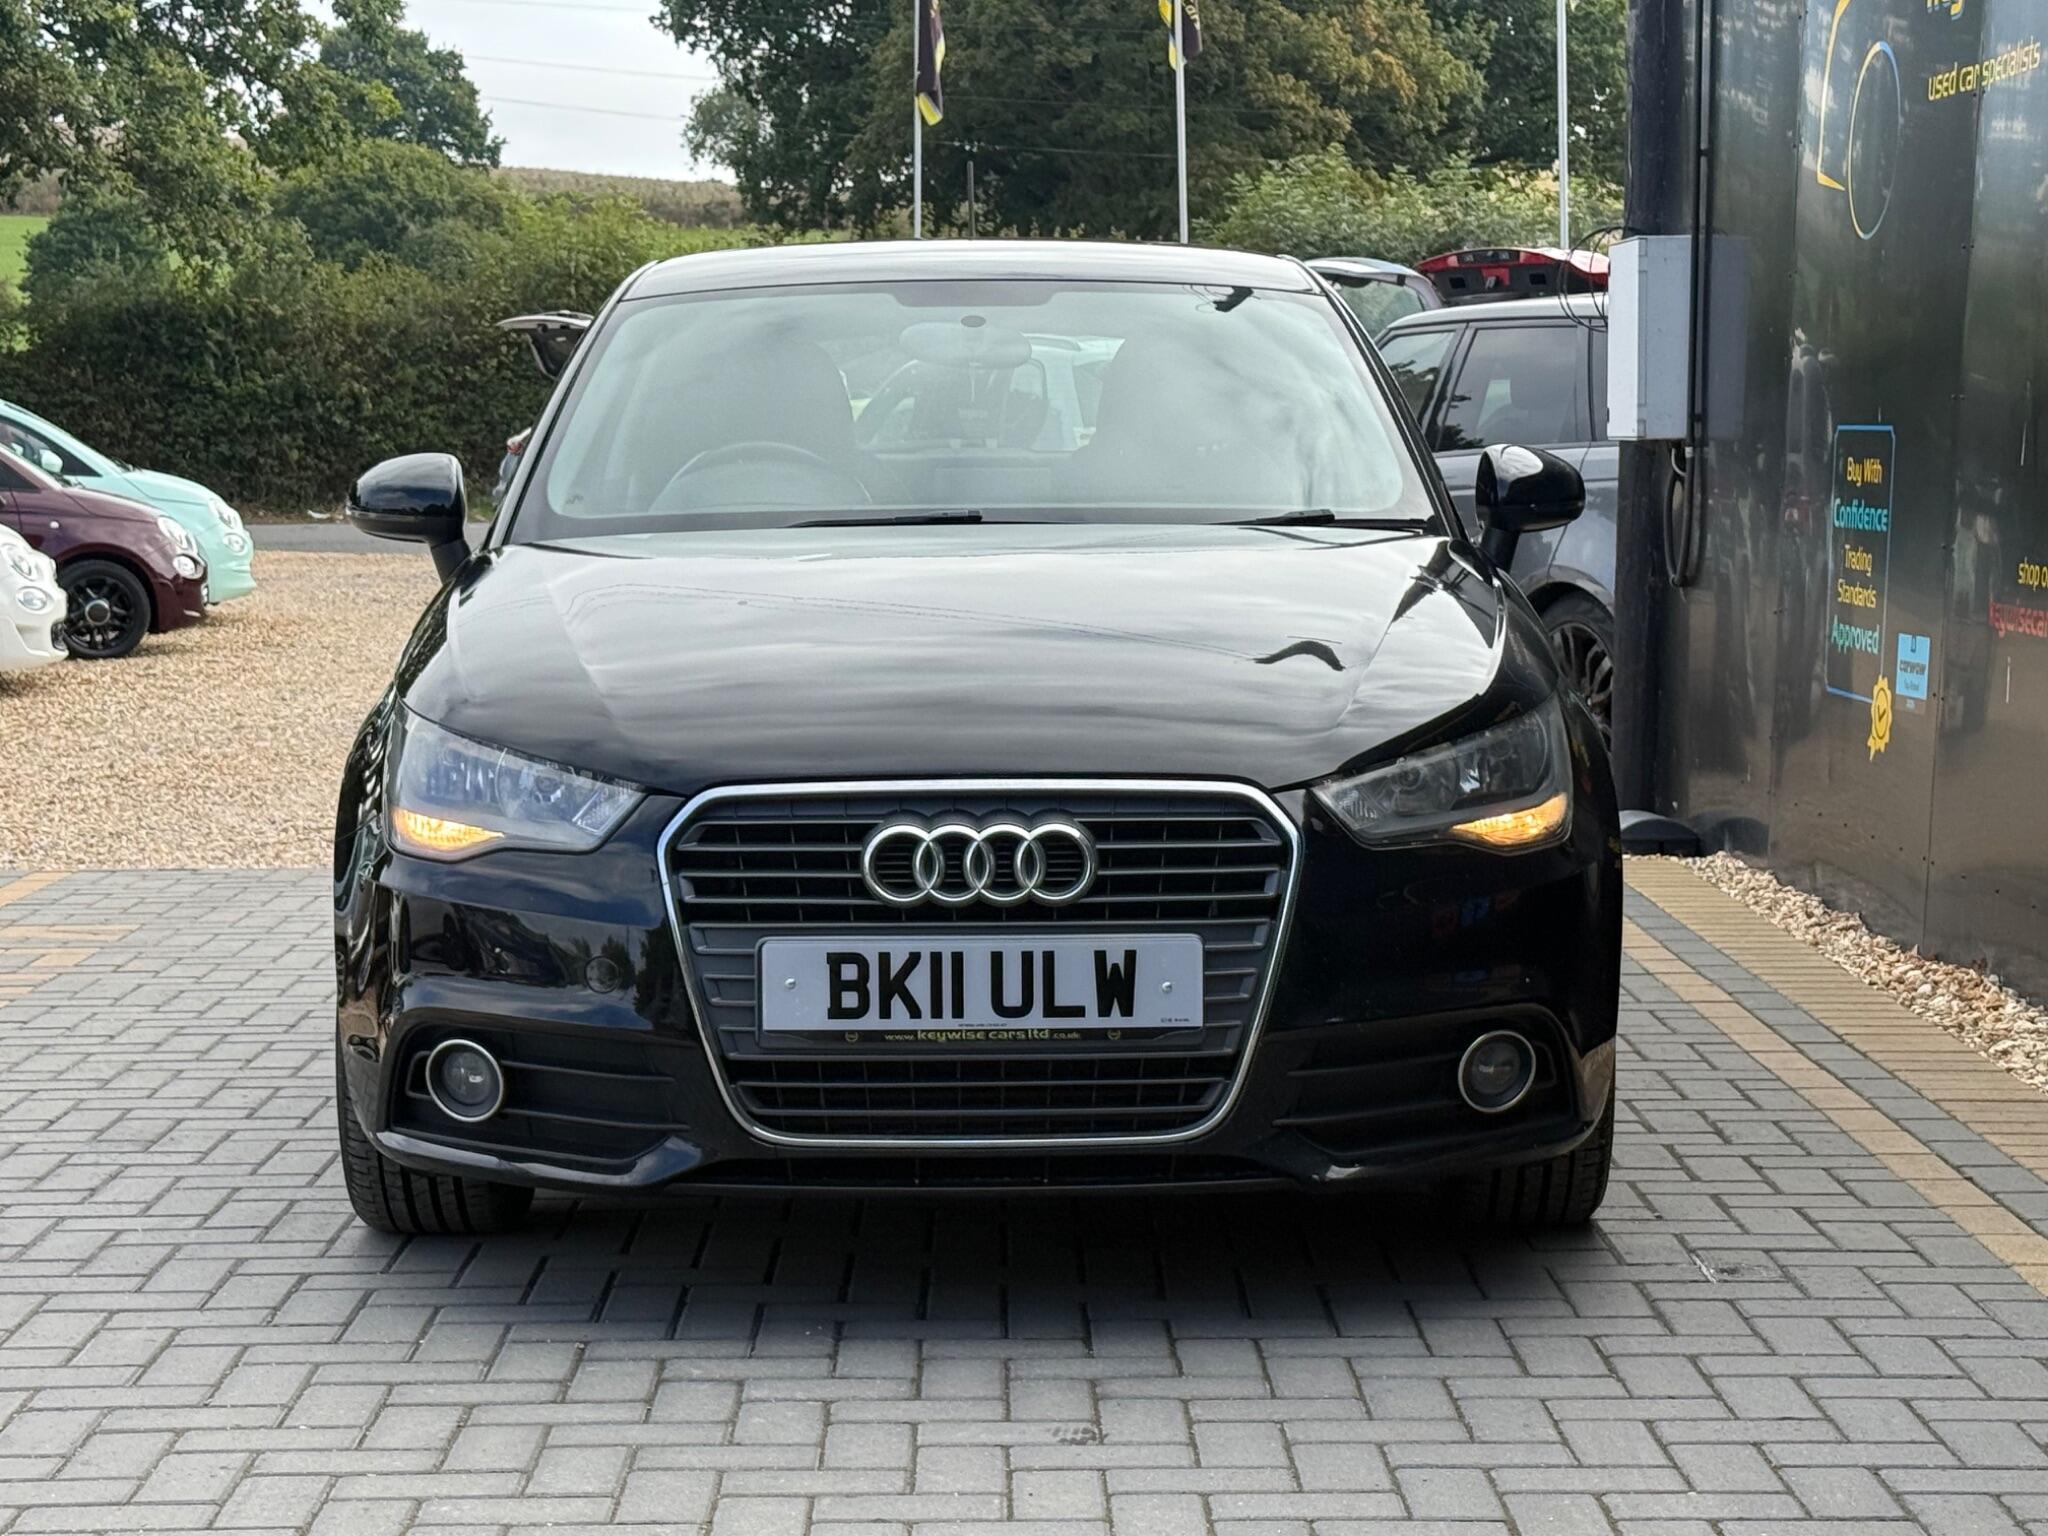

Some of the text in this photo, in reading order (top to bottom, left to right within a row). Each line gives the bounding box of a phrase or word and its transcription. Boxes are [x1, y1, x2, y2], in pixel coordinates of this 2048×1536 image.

[1928, 35, 2041, 101] used car specialists
[1846, 456, 1883, 487] Buy With
[1833, 497, 1888, 532] Confidence
[1844, 543, 1873, 577] Trading
[2017, 556, 2040, 592] shop
[1837, 578, 1877, 609] Standards
[1831, 614, 1880, 655] Approved
[826, 948, 1138, 1020] BK11 ULW
